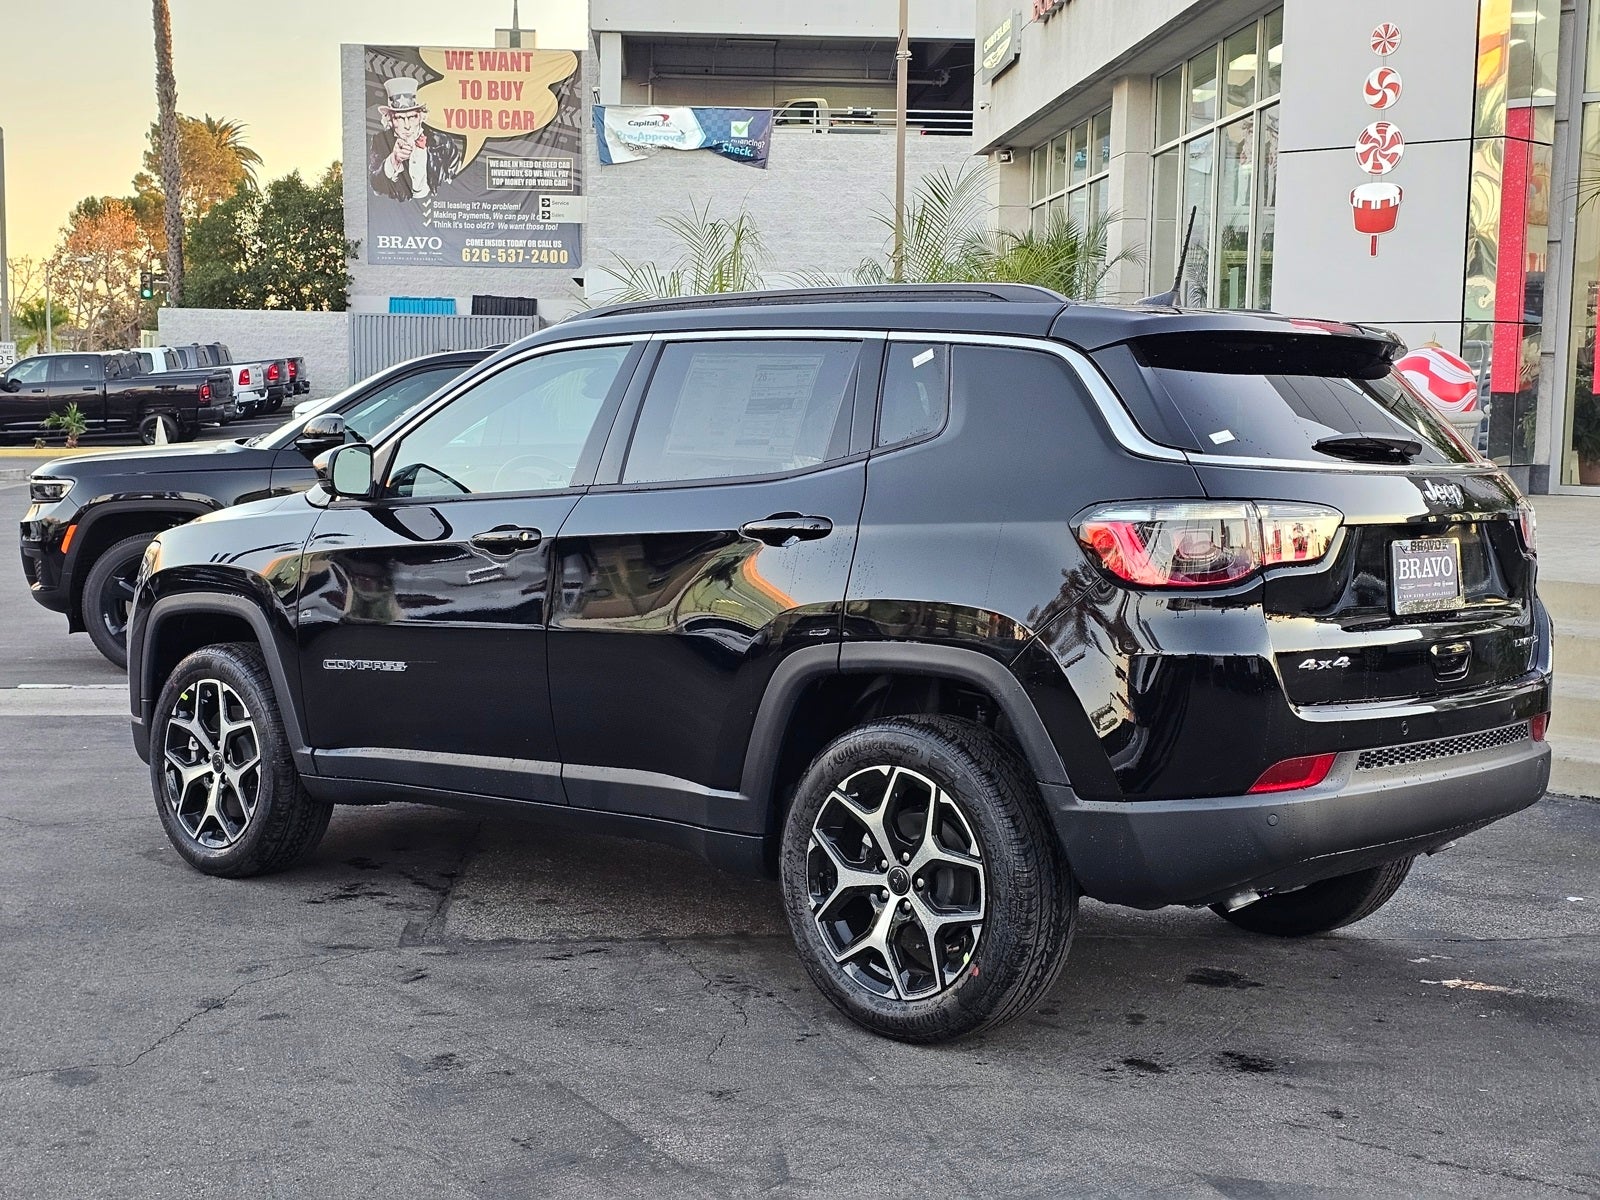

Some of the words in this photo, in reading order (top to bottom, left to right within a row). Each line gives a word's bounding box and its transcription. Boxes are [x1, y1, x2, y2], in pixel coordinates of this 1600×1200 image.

[445, 50, 474, 70] WE
[478, 51, 533, 72] WANT
[459, 80, 482, 100] TO
[488, 80, 524, 101] BUY
[444, 108, 492, 129] YOUR
[498, 110, 534, 130] CAR
[722, 142, 754, 157] Check.
[505, 178, 524, 186] MONEY
[433, 201, 446, 209] Still
[447, 202, 470, 210] leasing
[482, 202, 491, 210] No
[492, 203, 521, 211] problem!
[433, 211, 456, 220] Making
[458, 212, 491, 220] Payments,
[493, 212, 503, 220] We
[453, 221, 463, 229] it's
[498, 222, 508, 230] We
[377, 236, 442, 250] BRAVO
[466, 239, 484, 247] COME
[485, 239, 506, 247] INSIDE
[507, 240, 527, 248] TODAY
[528, 240, 536, 248] OR
[537, 240, 552, 248] CALL
[553, 240, 562, 248] US
[462, 248, 568, 264] 626-537-2400
[1422, 478, 1464, 508] Jeep
[1410, 540, 1441, 551] BRAVO
[1398, 556, 1453, 579] BRAVO
[323, 659, 408, 671] COMPASS
[1299, 656, 1351, 670] 4x4
